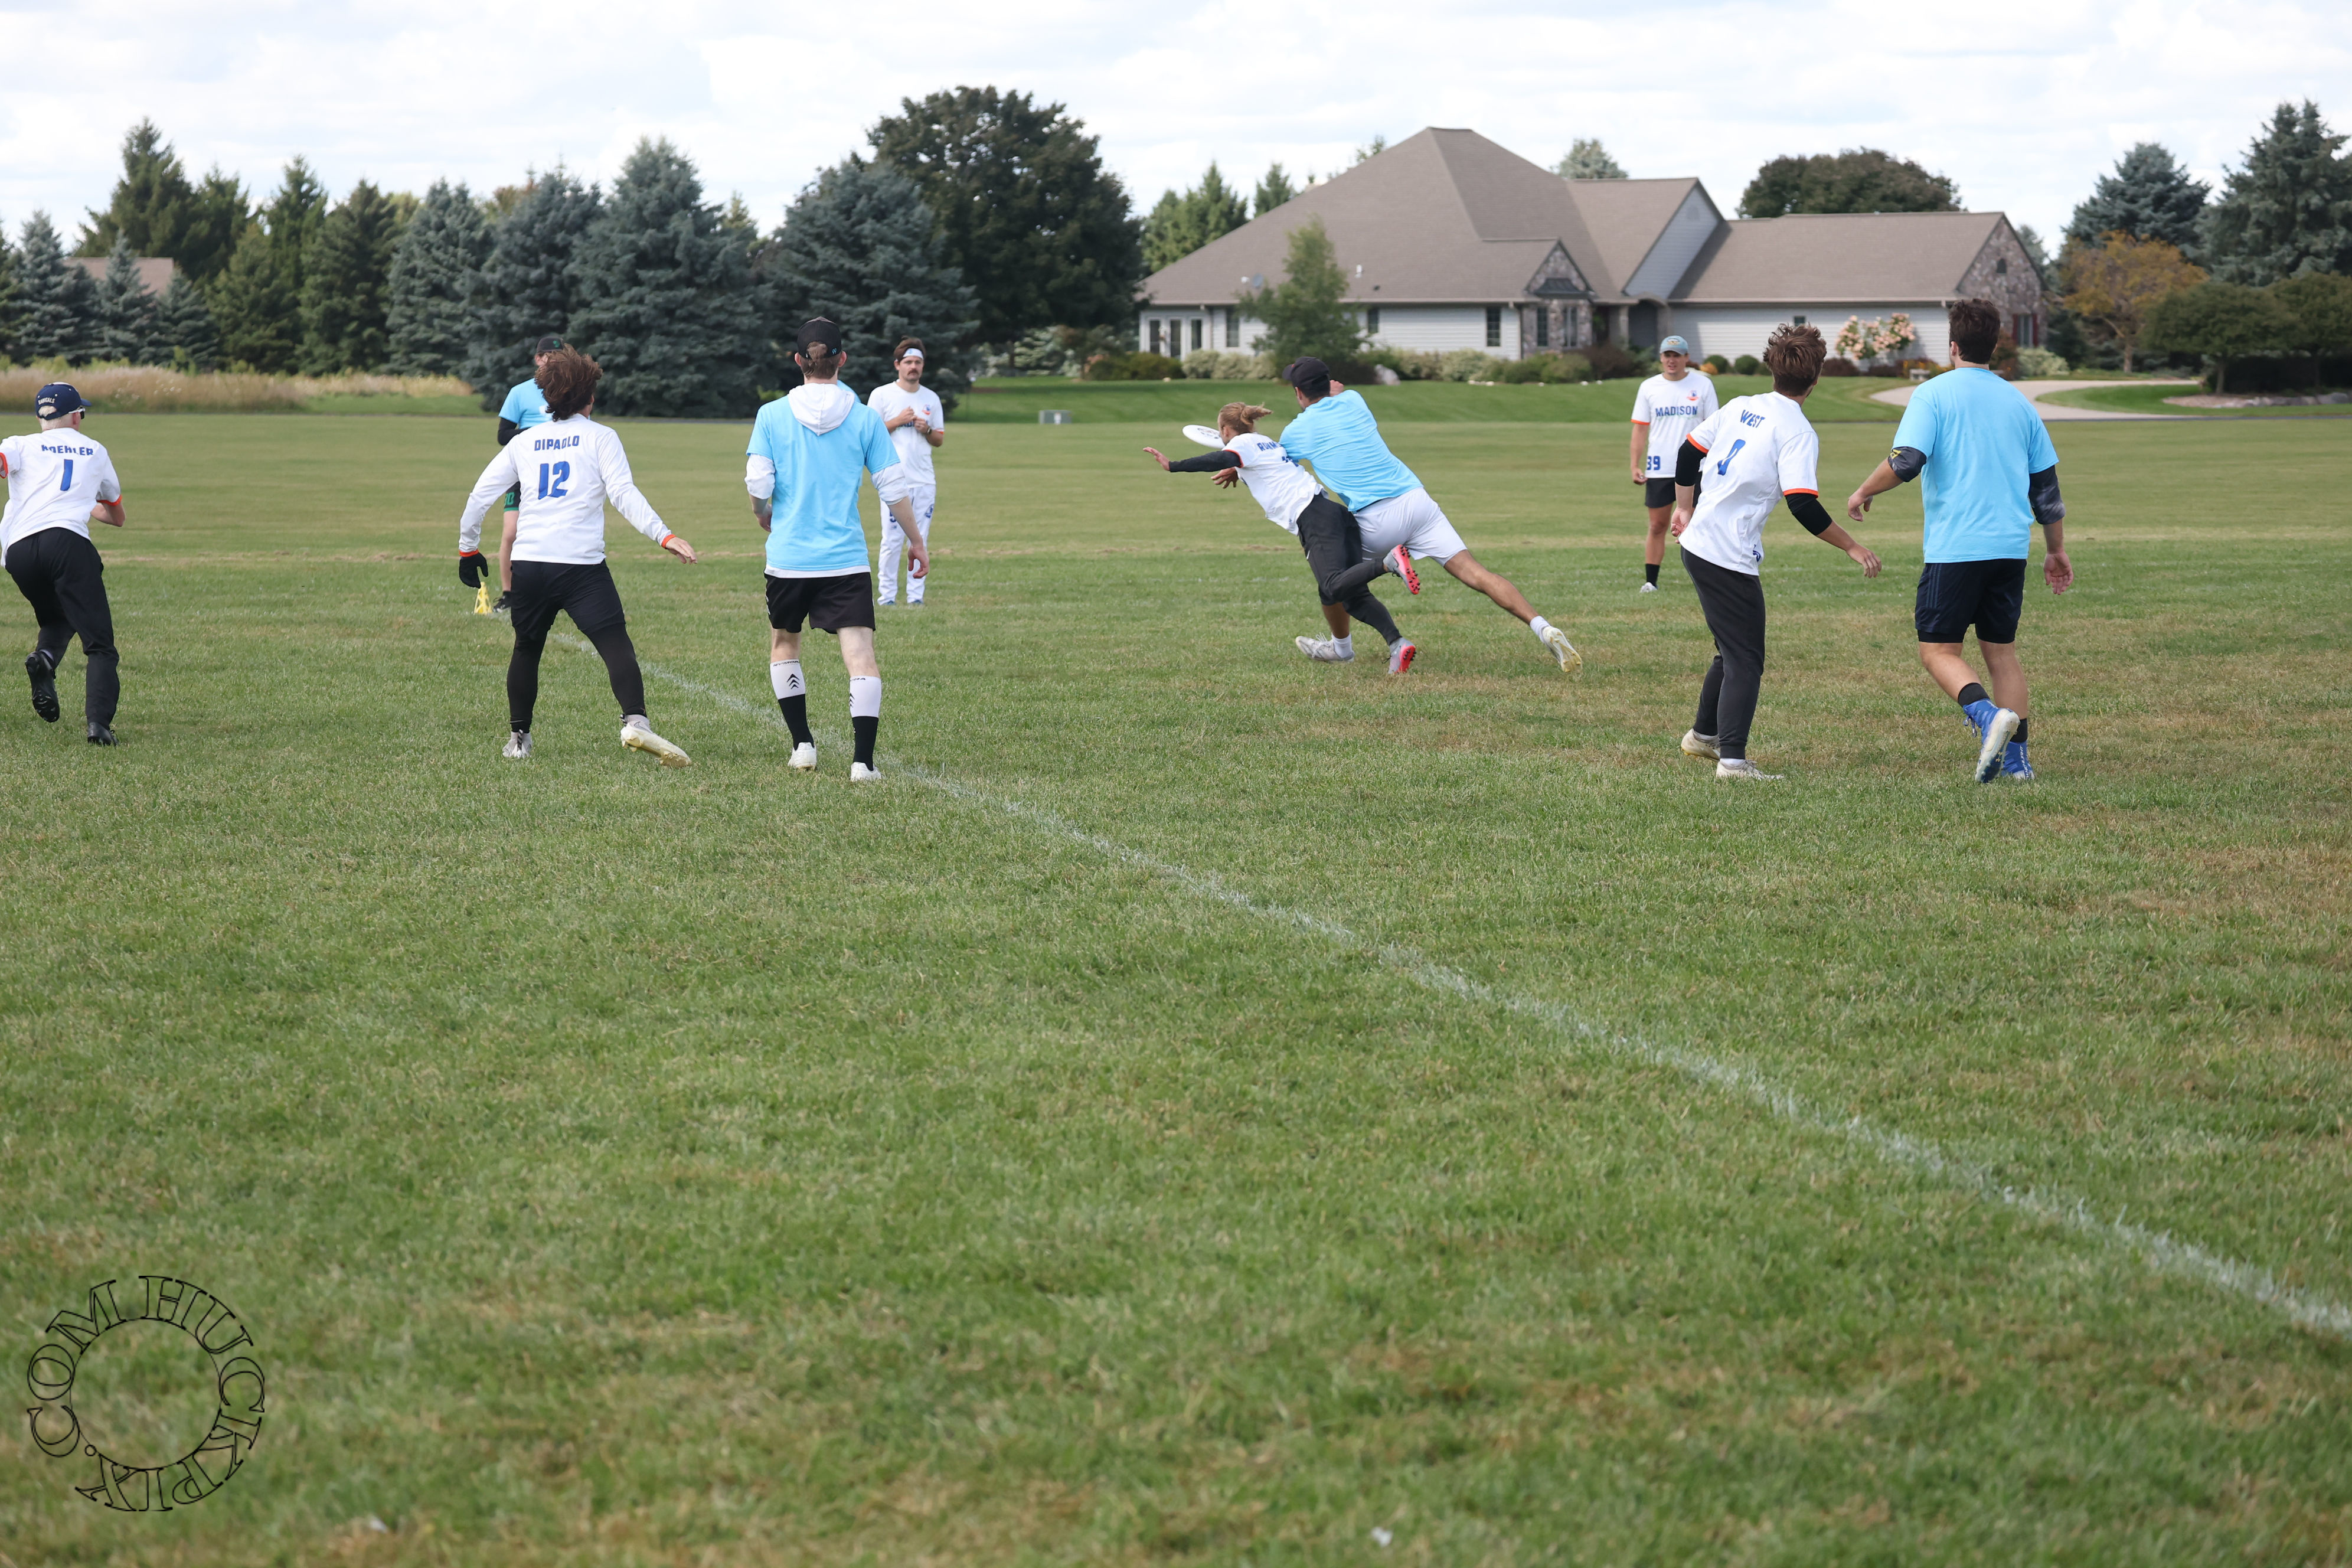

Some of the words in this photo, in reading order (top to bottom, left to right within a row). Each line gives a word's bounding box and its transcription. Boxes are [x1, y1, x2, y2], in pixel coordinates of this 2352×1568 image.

[1655, 406, 1698, 417] MADISON
[1740, 409, 1766, 428] WEST
[534, 435, 580, 451] DIPAOLO
[1647, 456, 1661, 471] 39
[60, 459, 73, 491] 1
[538, 460, 570, 500] 12
